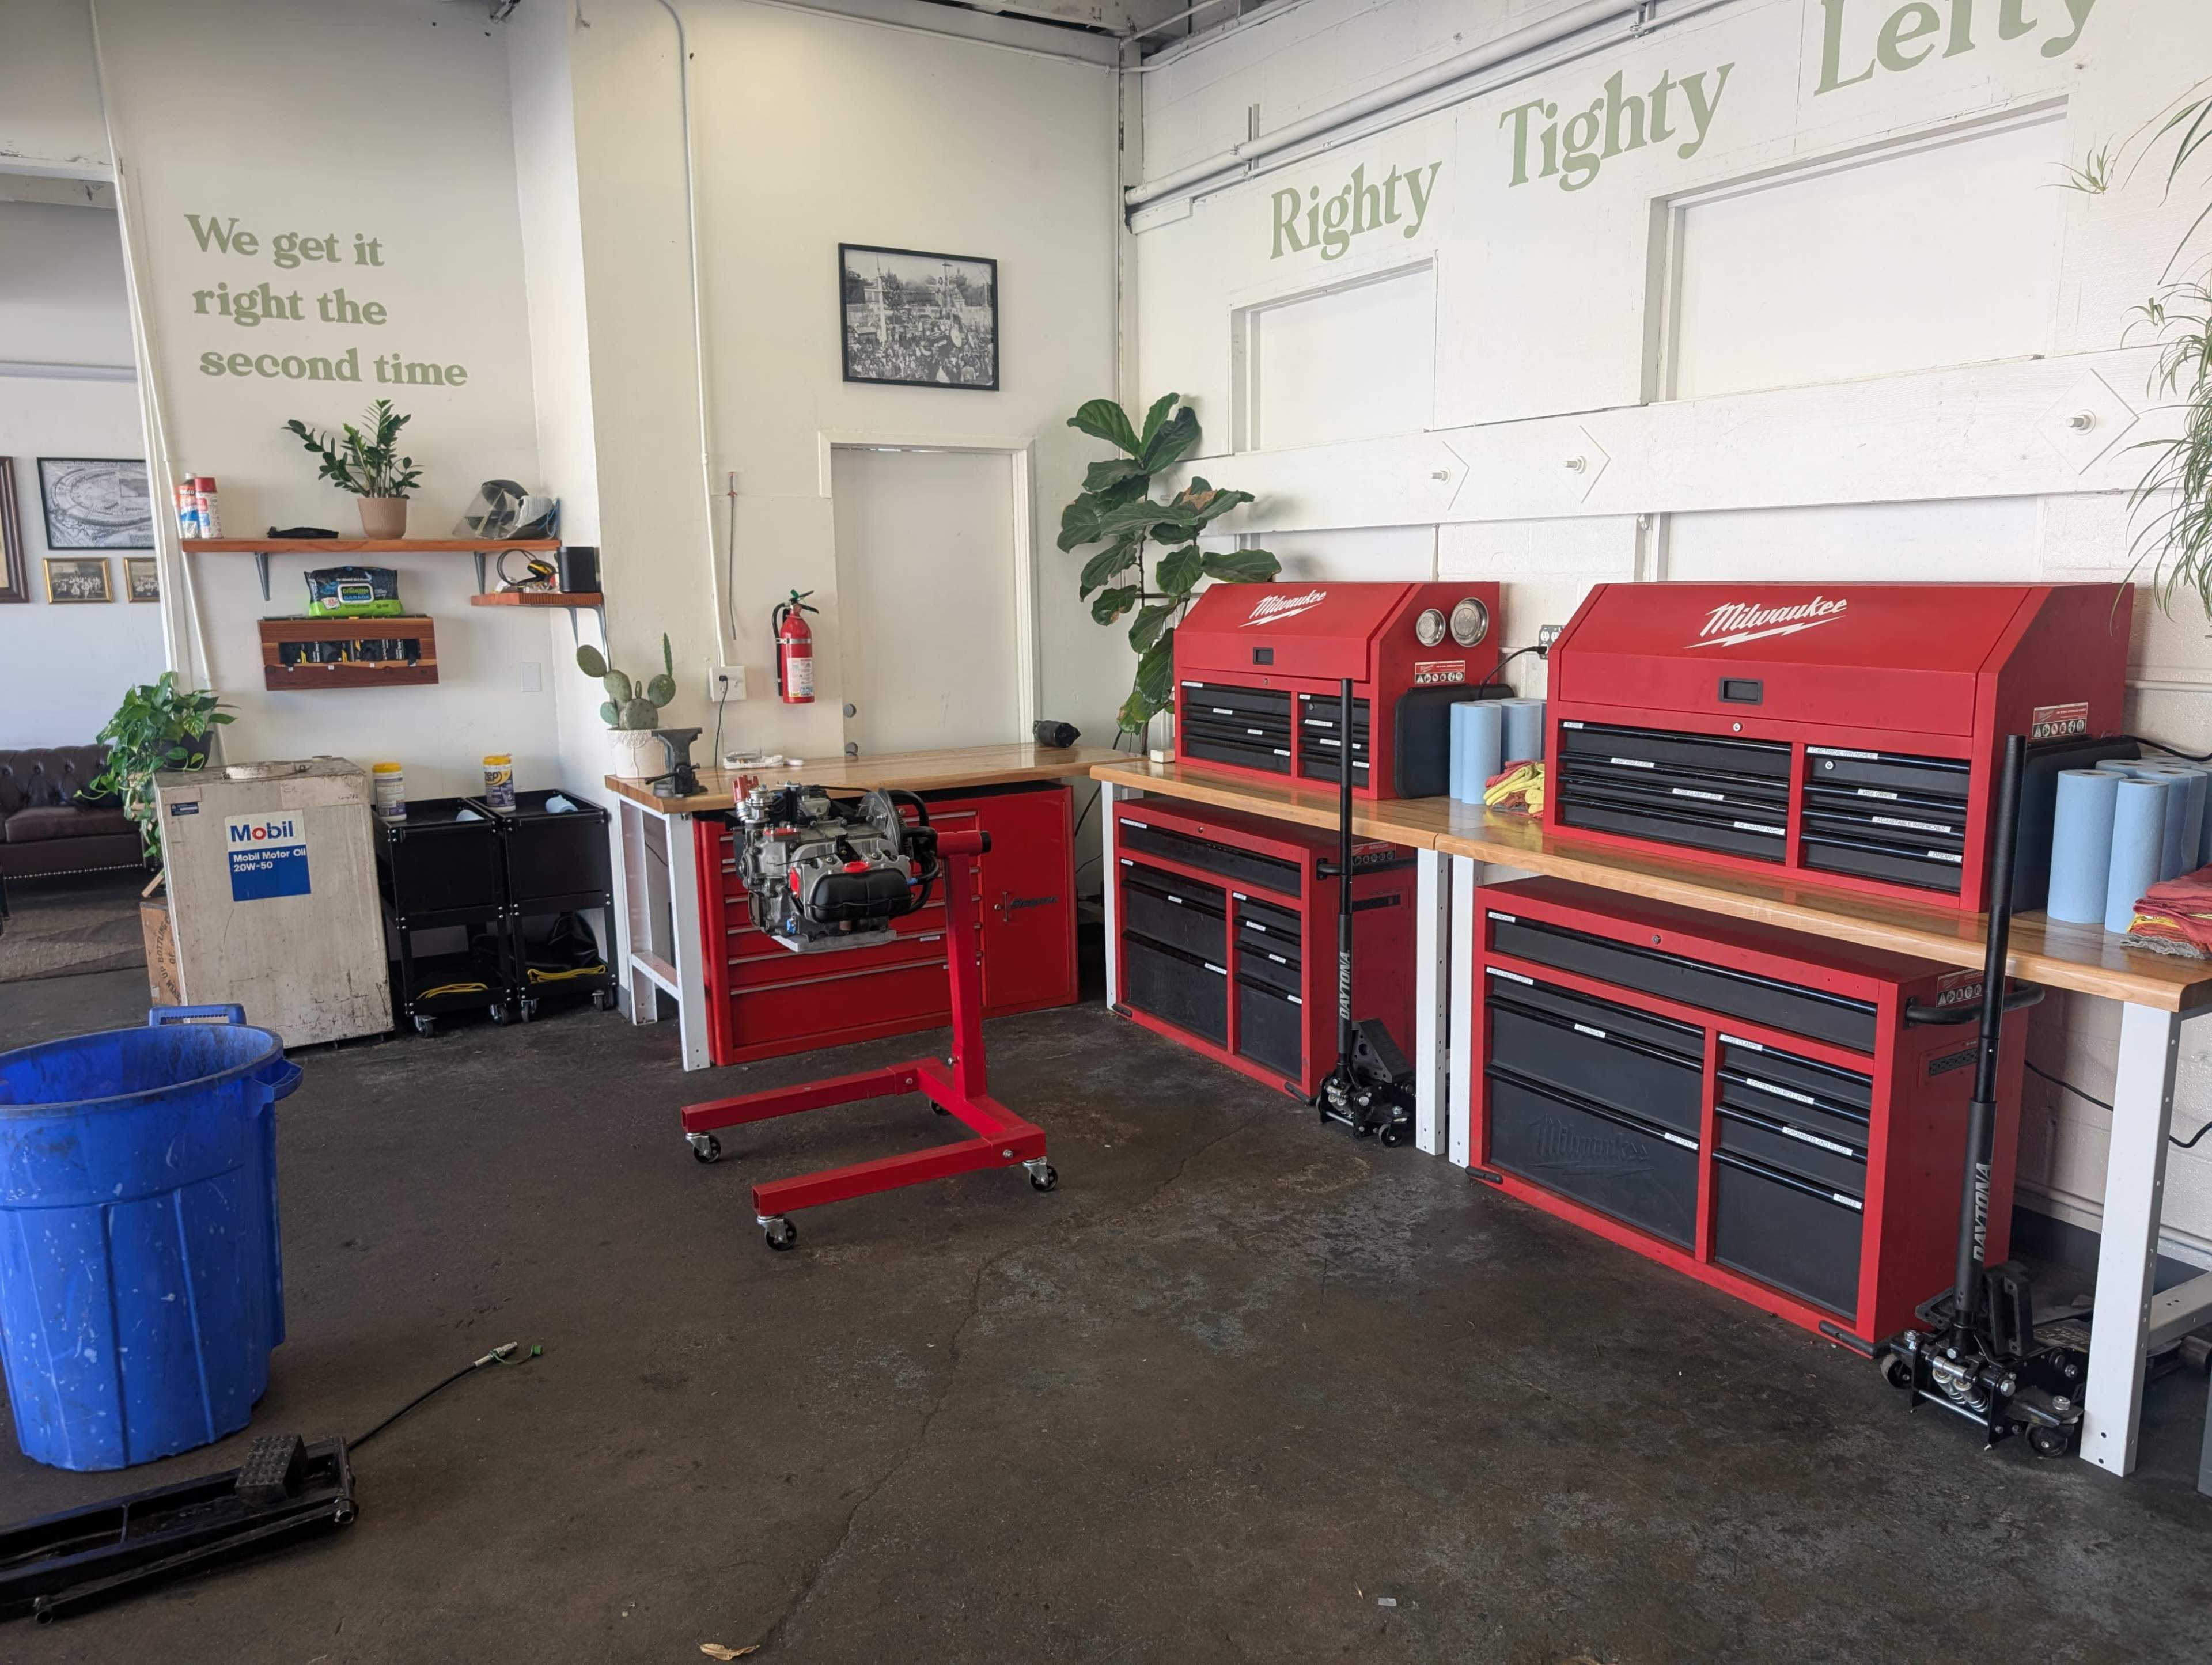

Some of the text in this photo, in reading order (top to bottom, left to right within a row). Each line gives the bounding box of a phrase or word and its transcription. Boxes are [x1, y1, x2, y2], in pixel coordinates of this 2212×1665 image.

[1270, 161, 1441, 260] Righty
[1499, 62, 1735, 192] Tighty
[184, 214, 385, 269] We get it
[192, 282, 387, 327] right the
[199, 347, 468, 386] second time
[1248, 589, 1327, 619] Milwaukee
[1700, 596, 1847, 637] Milwaukee
[1843, 750, 1873, 758] WRENCHES
[230, 820, 294, 843] Mobil
[1877, 817, 1945, 831] ADJUSTABLE WRENCHES
[233, 848, 306, 862] Mobil Motor Oil
[234, 861, 273, 872] 20W-50
[1933, 852, 1956, 860] DREMEL
[157, 921, 168, 964] BOTTLING
[161, 966, 168, 979] UP
[1339, 951, 1350, 1021] DAYTONA
[1751, 1080, 1770, 1090] COTTER
[1783, 1090, 1796, 1098] ROLL
[1797, 1094, 1809, 1102] PINS
[1529, 1113, 1649, 1163] Milwaukee
[1787, 1129, 1848, 1154] GROMMETS AND PLUGS
[1838, 1196, 1857, 1207] HOSES
[1973, 1162, 1992, 1263] DAYTONA
